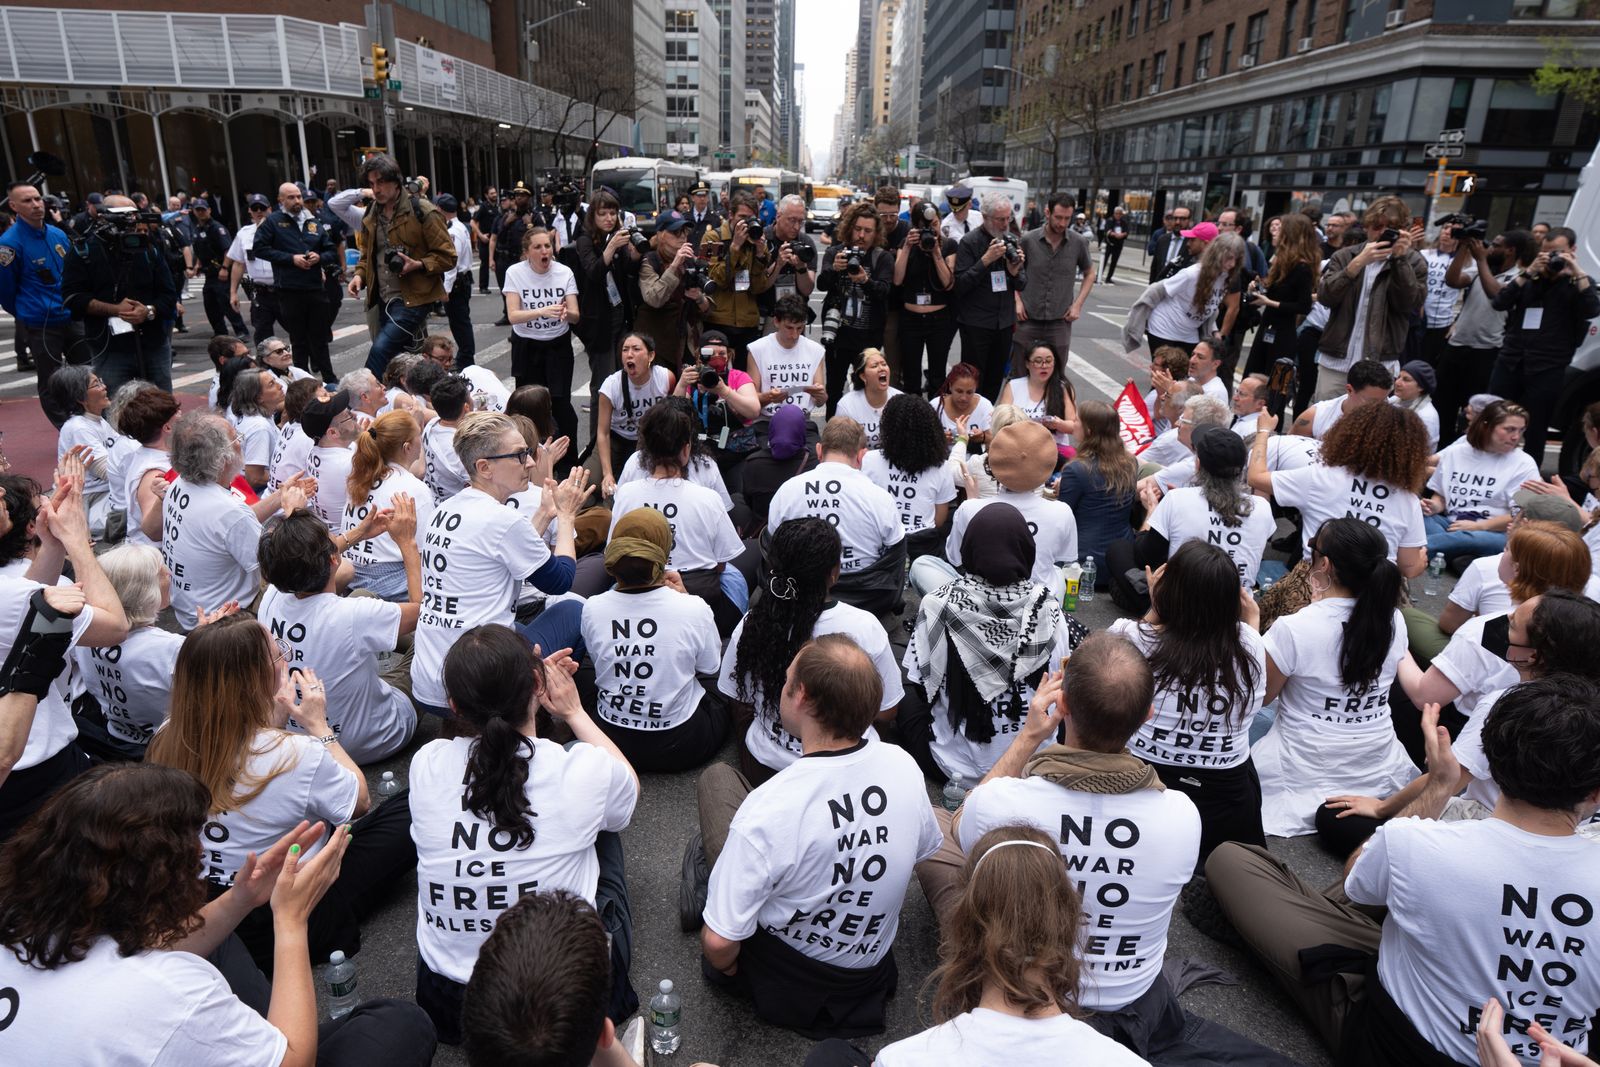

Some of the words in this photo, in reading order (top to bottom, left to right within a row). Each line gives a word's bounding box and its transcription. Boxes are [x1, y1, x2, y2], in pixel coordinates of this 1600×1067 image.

[522, 287, 565, 299] FUND
[770, 372, 809, 383] FUND
[786, 395, 803, 405] OT
[805, 480, 841, 495] NO
[889, 473, 918, 484] WAR
[1450, 472, 1496, 486] FUND
[170, 484, 189, 510] NO
[887, 485, 916, 499] NO
[1351, 479, 1389, 499] NO
[345, 503, 368, 520] NO
[807, 499, 840, 508] WAR
[1350, 497, 1385, 513] WAR
[167, 503, 183, 525] WAR
[430, 510, 462, 531] NO
[165, 518, 179, 541] NO
[1208, 530, 1242, 545] NO
[425, 532, 451, 549] WAR
[422, 550, 447, 573] NO
[424, 575, 442, 590] ICE
[271, 618, 306, 643] NO
[612, 618, 658, 639] NO
[90, 645, 122, 664] NO
[615, 645, 655, 657] WAR
[95, 664, 121, 681] WAR
[614, 661, 653, 679] NO
[100, 680, 127, 704] NO
[1325, 690, 1387, 712] FREE
[109, 703, 131, 719] ICE
[1176, 692, 1229, 716] NO
[1181, 719, 1219, 733] ICE
[1151, 727, 1233, 752] FREE
[828, 785, 887, 829] NO
[452, 821, 519, 852] NO
[837, 826, 888, 852] WAR
[1060, 814, 1139, 849] NO
[456, 860, 505, 877] ICE
[831, 854, 887, 886] NO
[1062, 854, 1135, 876] WAR
[827, 890, 873, 907] ICE
[1501, 884, 1593, 927] NO
[787, 908, 886, 937] FREE
[1503, 927, 1584, 956] WAR
[1497, 954, 1577, 987] NO
[1507, 990, 1562, 1009] ICE
